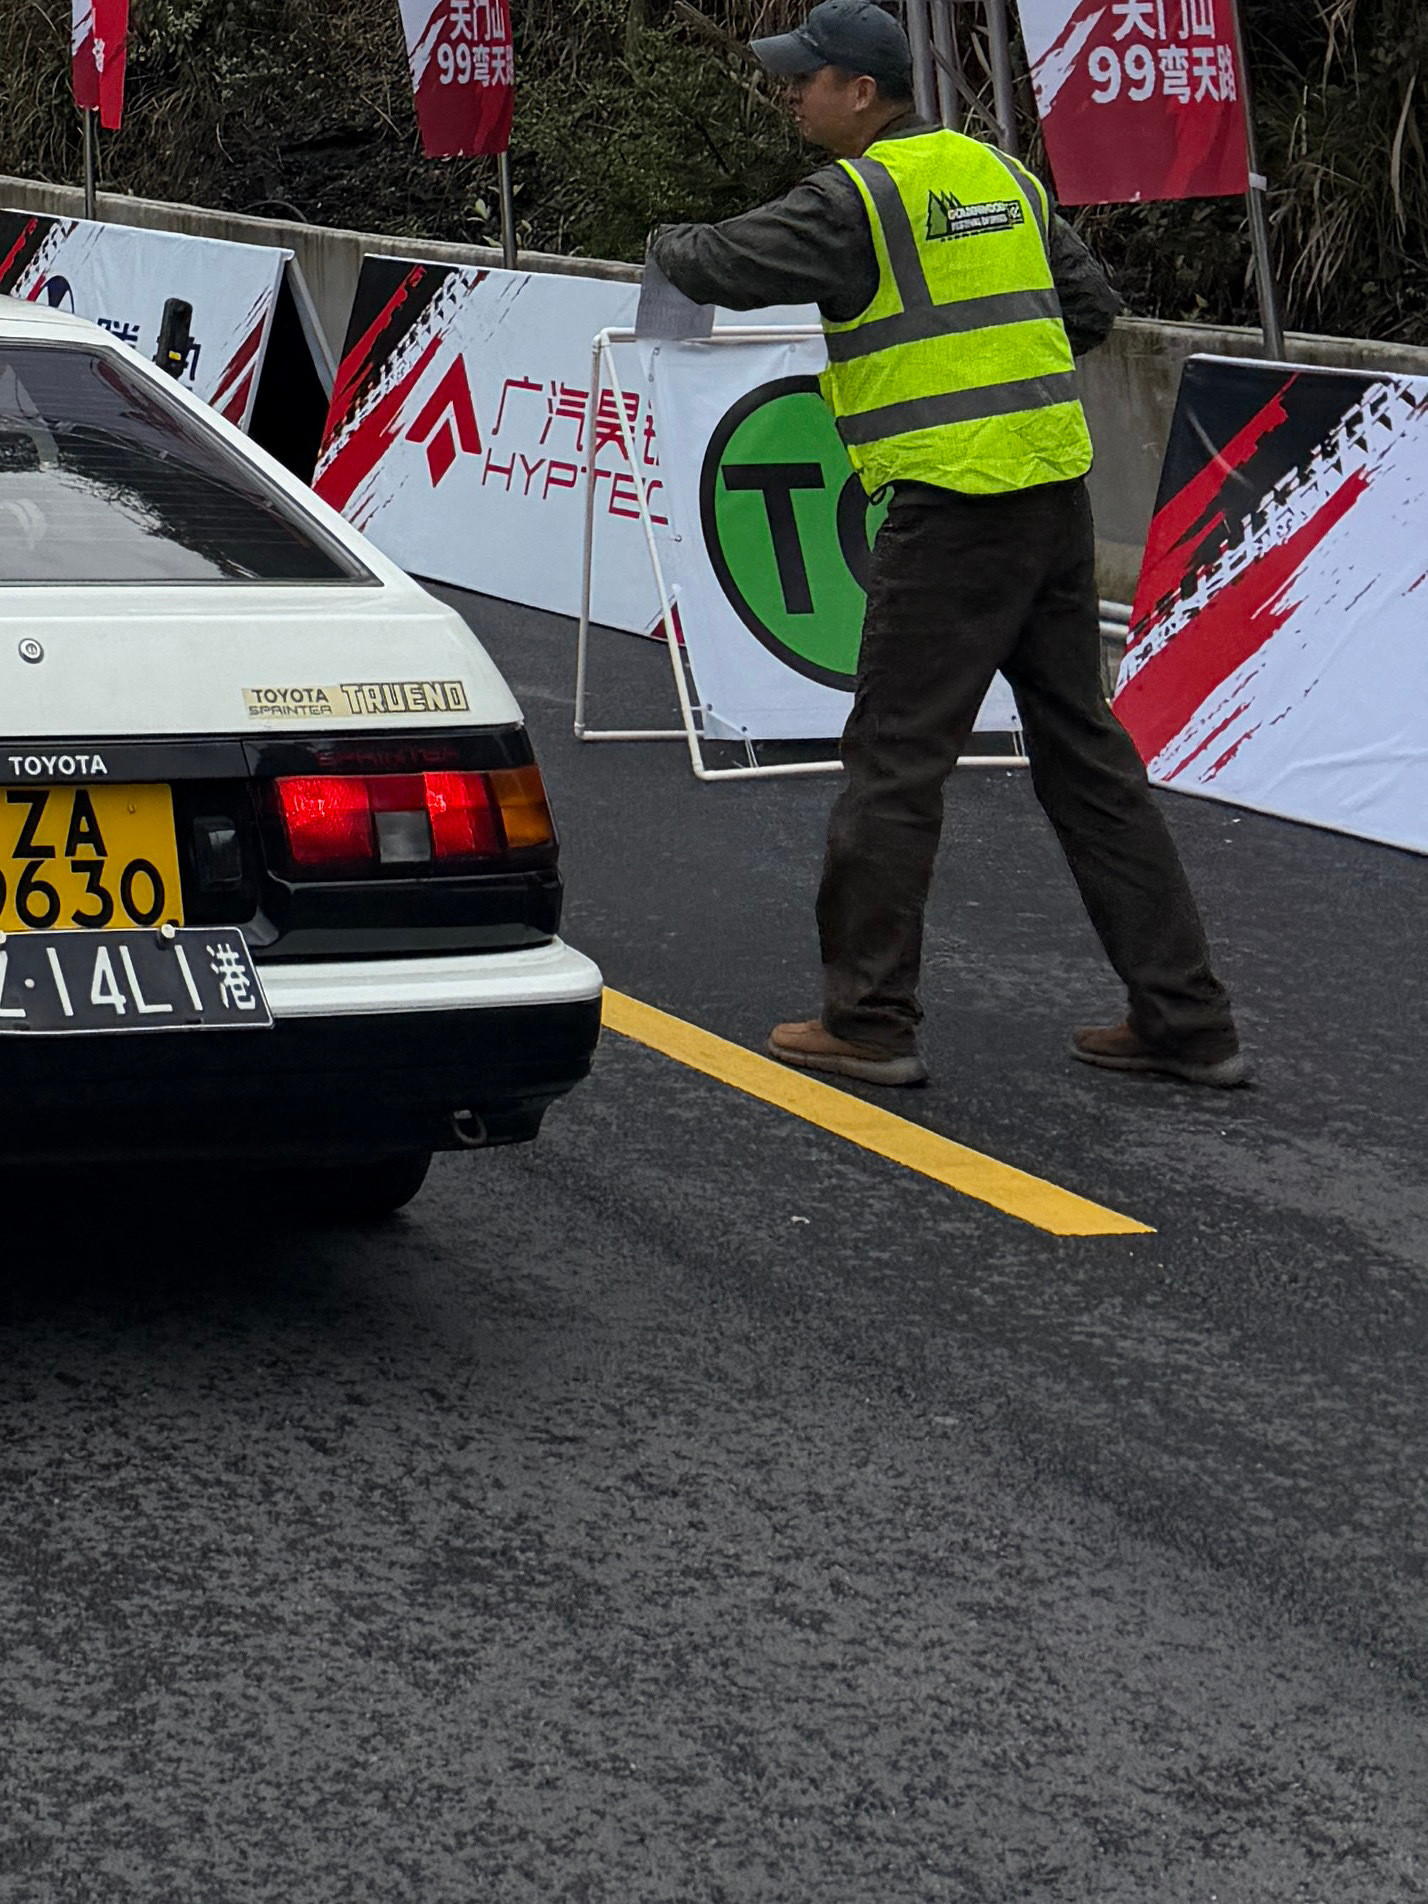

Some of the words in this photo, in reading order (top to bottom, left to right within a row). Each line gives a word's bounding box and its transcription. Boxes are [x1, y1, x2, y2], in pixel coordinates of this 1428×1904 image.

[247, 704, 333, 716] SPRINTER
[250, 688, 330, 704] TOYOTA
[339, 679, 471, 715] TRUENO
[8, 754, 108, 776] TOYOTA
[5, 789, 109, 859] ZA
